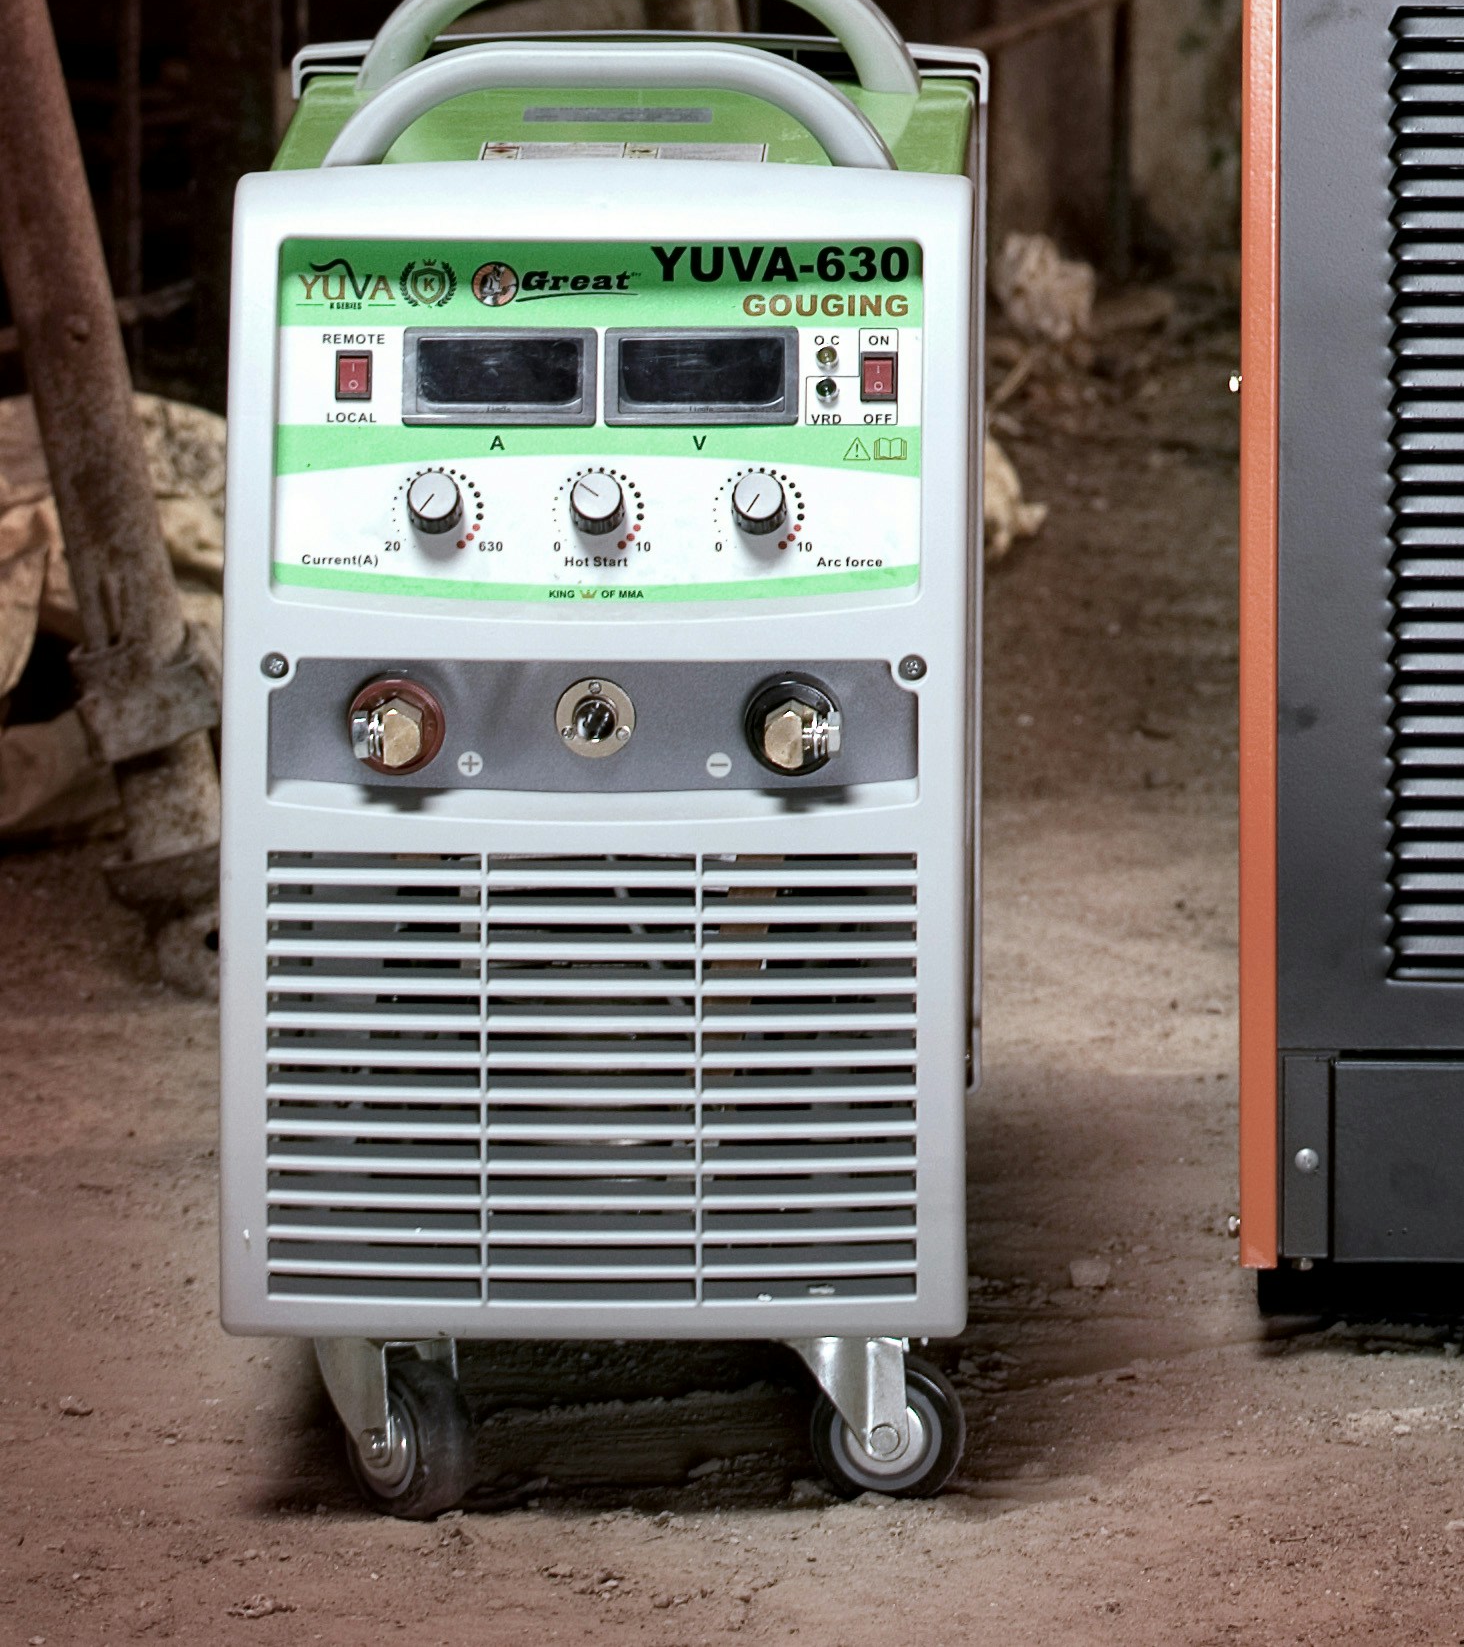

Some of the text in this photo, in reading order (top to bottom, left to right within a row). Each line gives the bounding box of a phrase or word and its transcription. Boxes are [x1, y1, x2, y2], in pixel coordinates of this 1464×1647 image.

[651, 246, 909, 283] YUVA-630
[299, 258, 395, 300] YUVA
[423, 277, 435, 291] K
[521, 270, 631, 291] Great
[742, 294, 909, 317] GOUGING
[322, 333, 386, 345] REMOTE
[869, 335, 889, 346] ON
[326, 412, 377, 424] LOCAL
[811, 413, 842, 425] VRD
[863, 413, 893, 424] OFF
[489, 435, 506, 451] A
[693, 435, 707, 451] V
[384, 541, 401, 552] 20
[479, 541, 503, 552] 630
[554, 541, 561, 552] 0
[636, 541, 651, 552] 10
[714, 541, 722, 552] 0
[797, 541, 813, 552] 10
[301, 554, 379, 568] Current(A)
[565, 557, 628, 568] Hot Start
[817, 556, 883, 568] Arc force
[549, 589, 644, 599] KING OF MMA
